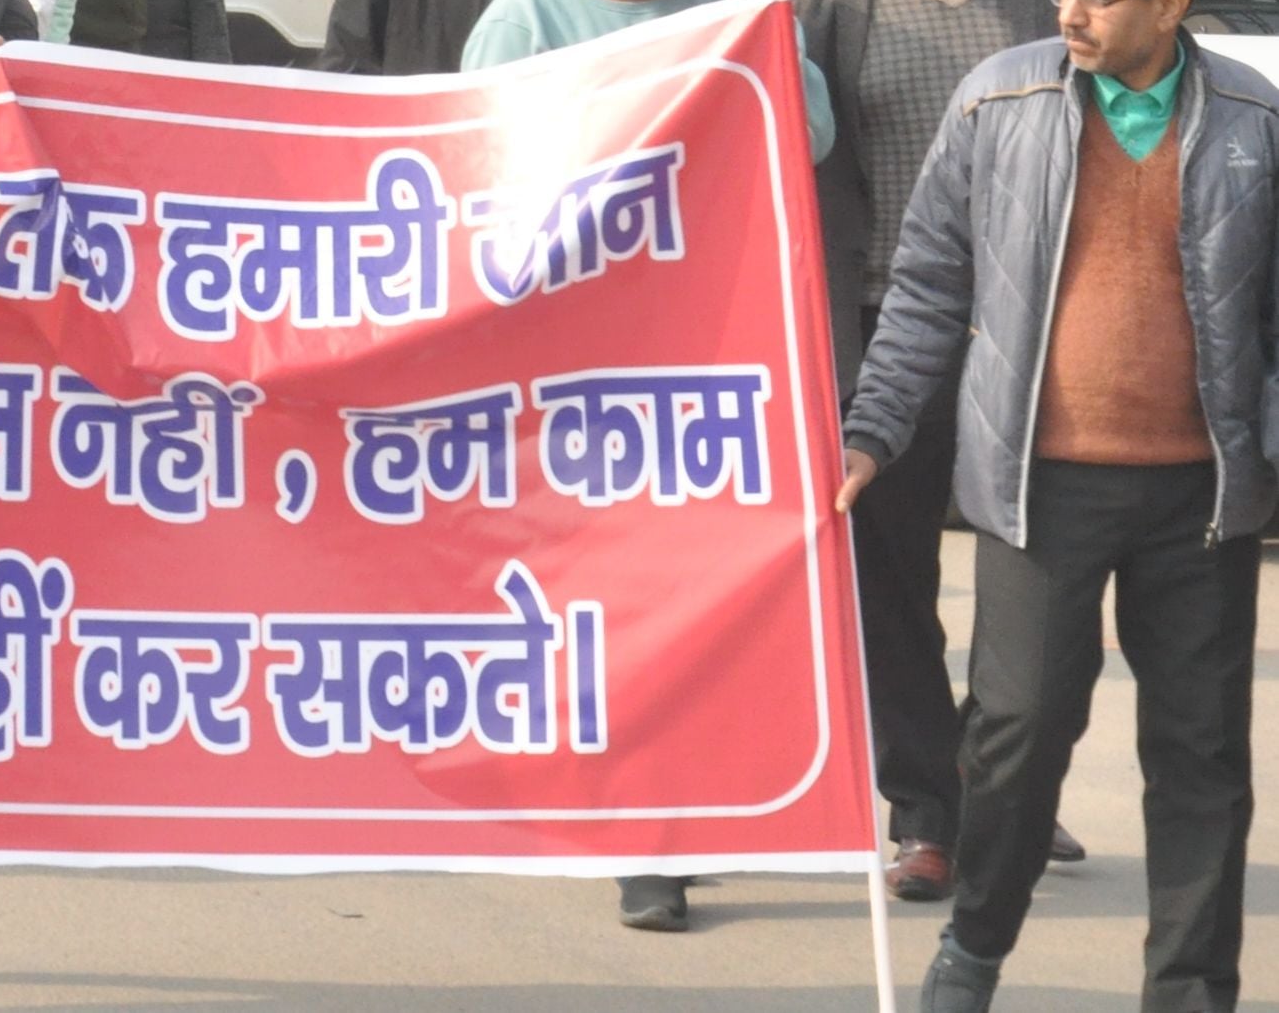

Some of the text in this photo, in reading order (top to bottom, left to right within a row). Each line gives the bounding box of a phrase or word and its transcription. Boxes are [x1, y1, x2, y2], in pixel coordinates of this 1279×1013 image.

[157, 150, 449, 339] हमारी
[469, 144, 684, 307] जान
[54, 373, 265, 523] नहीं
[345, 385, 522, 523] हम
[535, 366, 771, 506] काम
[73, 614, 257, 756] कर
